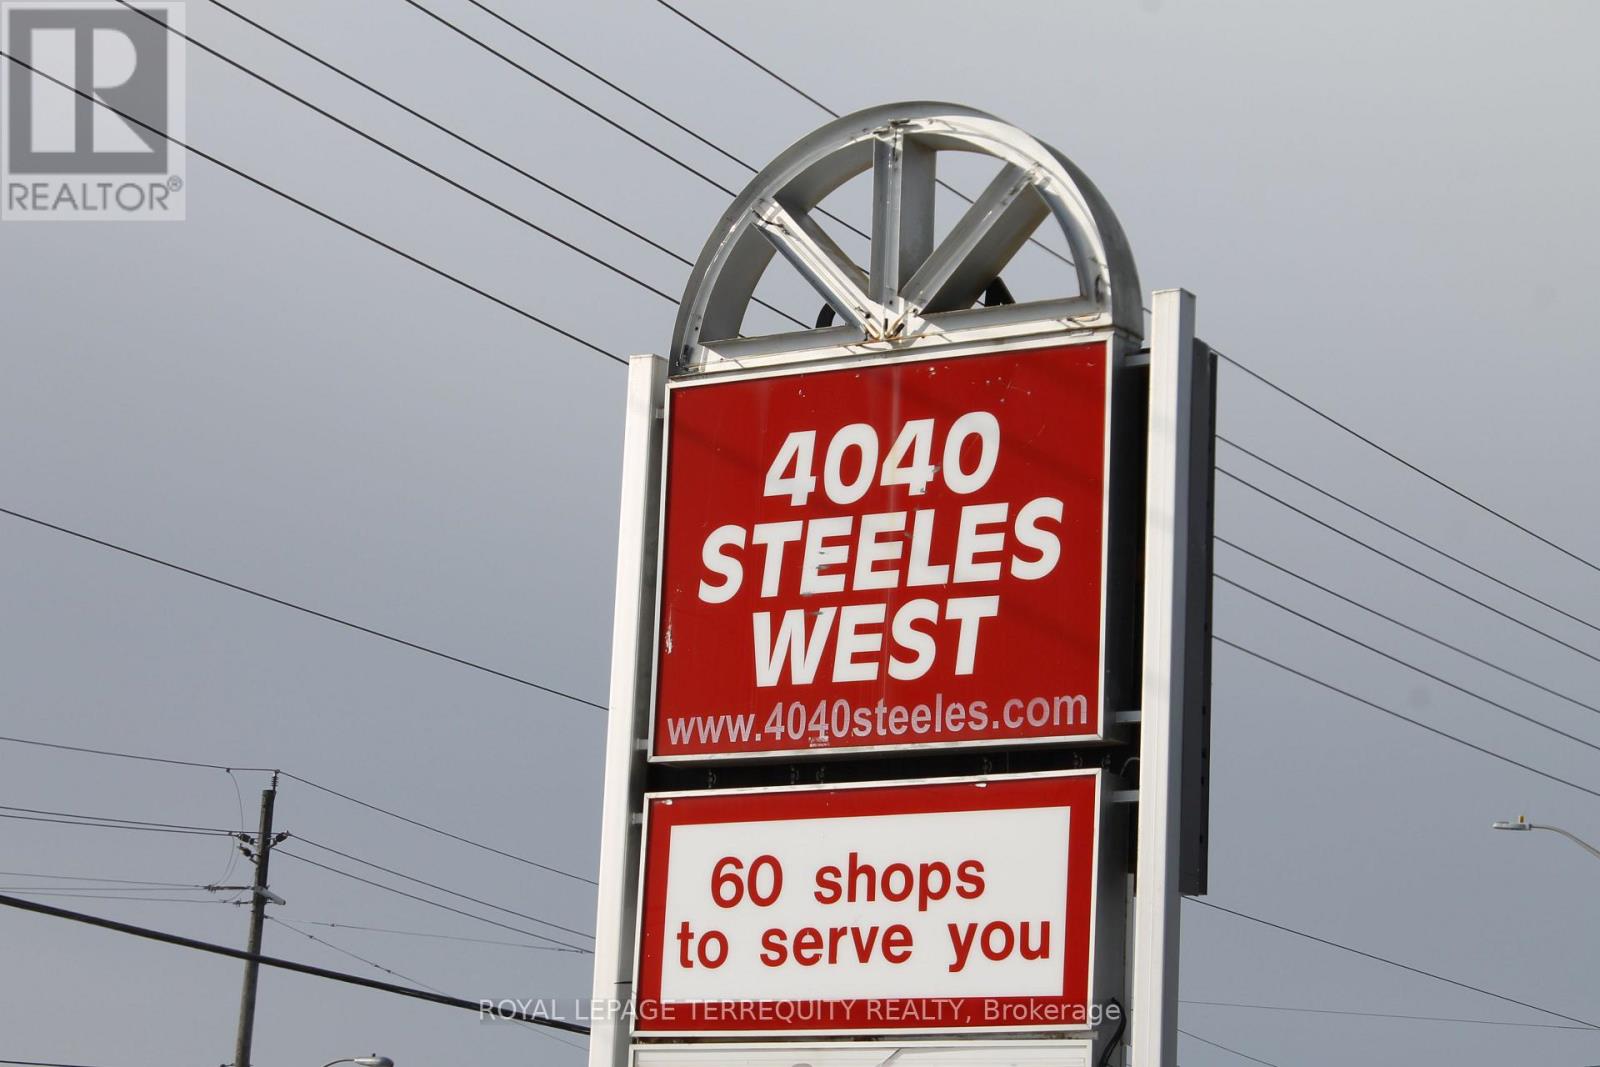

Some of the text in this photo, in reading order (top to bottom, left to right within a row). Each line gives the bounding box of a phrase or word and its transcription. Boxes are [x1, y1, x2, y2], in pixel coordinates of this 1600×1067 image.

[763, 411, 1001, 506] 4040
[698, 497, 1064, 604] STEELES
[752, 595, 1000, 687] WEST
[667, 693, 1088, 745] www.4040steeles.com
[711, 852, 986, 911] 60 shops
[676, 920, 1051, 972] to serve you
